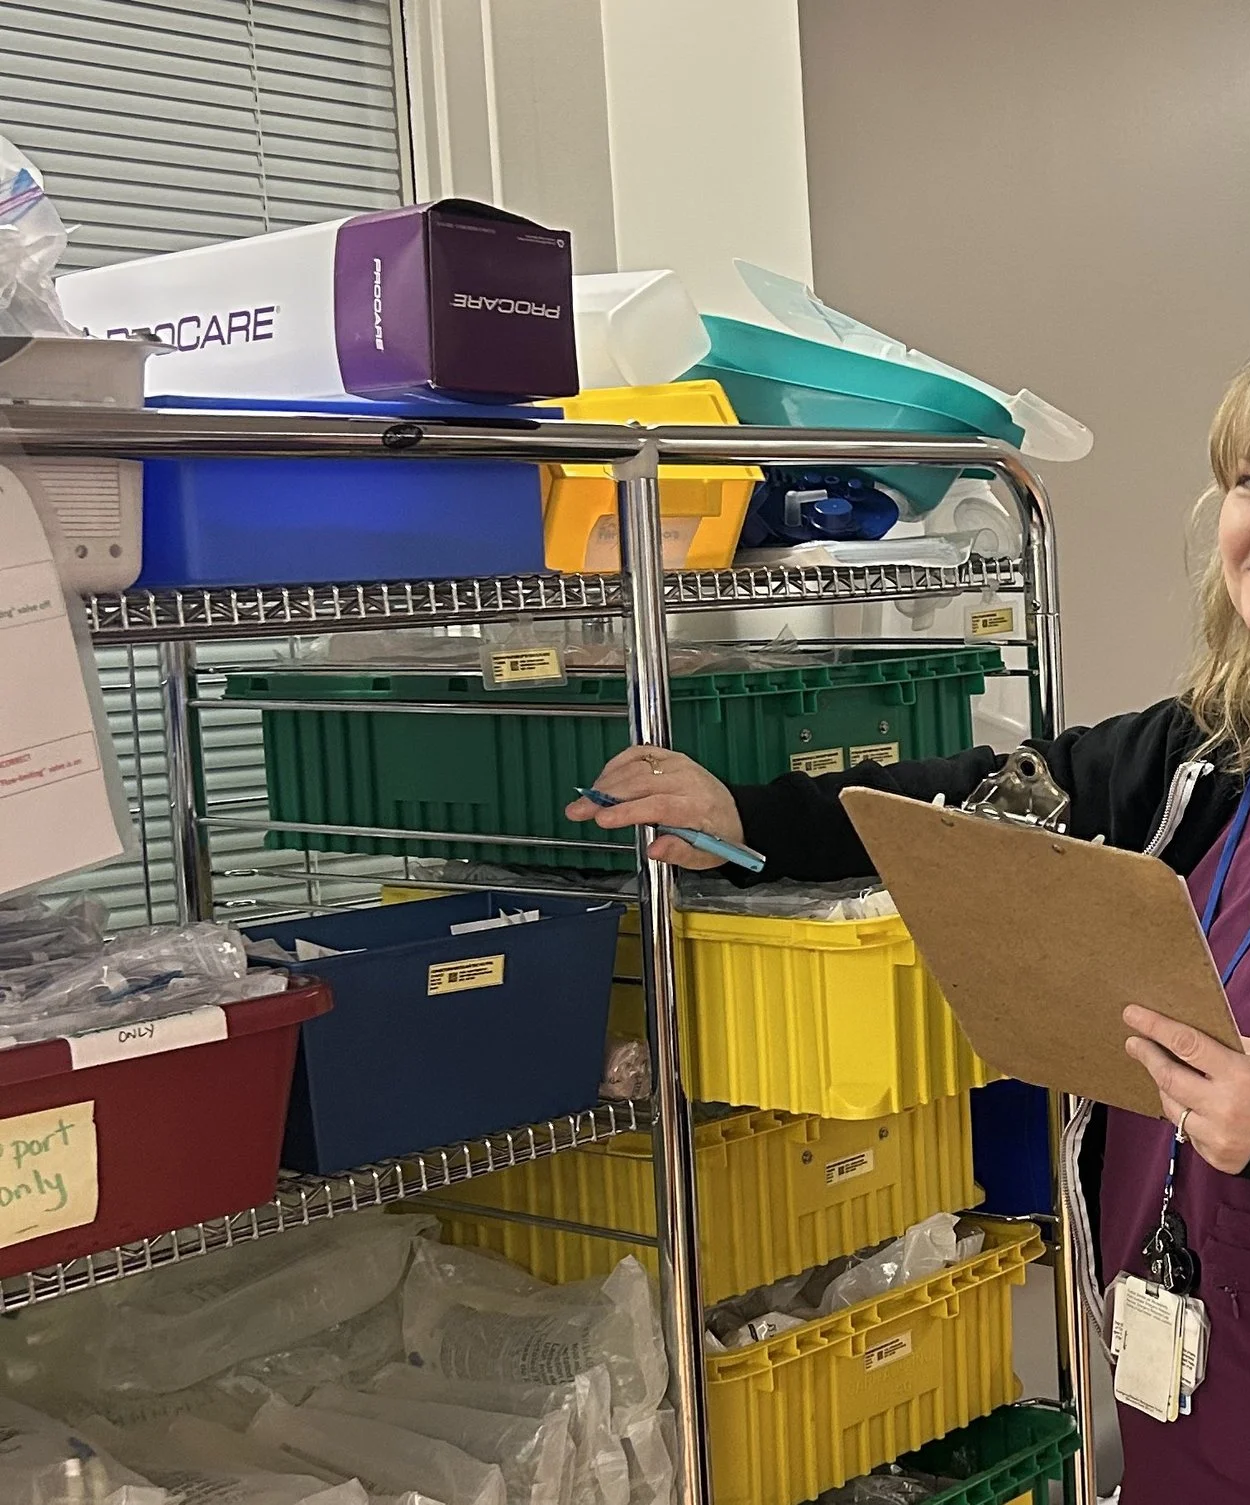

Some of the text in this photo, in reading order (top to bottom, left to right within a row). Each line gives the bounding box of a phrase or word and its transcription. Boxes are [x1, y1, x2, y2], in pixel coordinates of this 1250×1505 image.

[373, 258, 384, 351] PROCARE
[452, 293, 561, 319] PROCARE
[118, 1024, 155, 1043] ONLY
[12, 1119, 76, 1169] port
[0, 1169, 68, 1213] only
